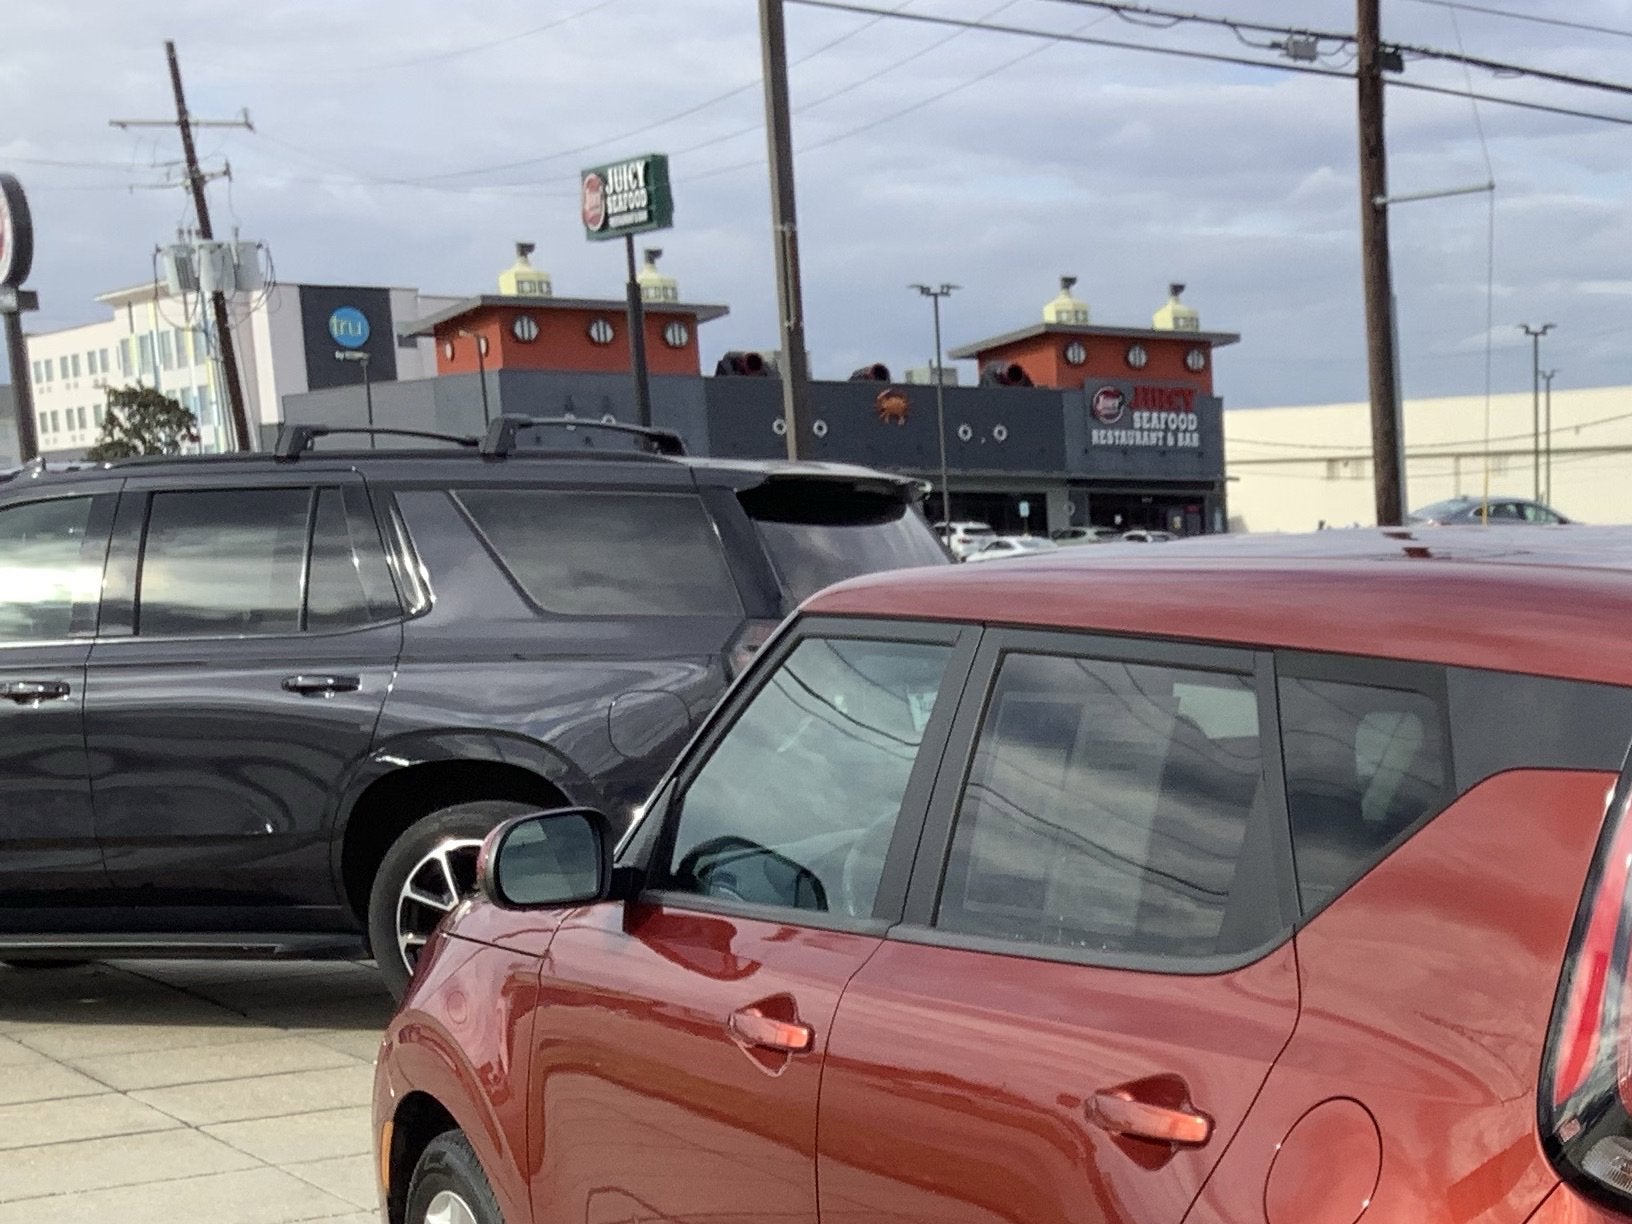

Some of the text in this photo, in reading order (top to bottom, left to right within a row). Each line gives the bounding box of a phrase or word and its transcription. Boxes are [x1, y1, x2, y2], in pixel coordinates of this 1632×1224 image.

[605, 160, 646, 194] JUICY
[606, 188, 648, 214] SEAFOOD
[331, 314, 362, 337] tru
[1132, 411, 1198, 431] SEAFOOD
[1091, 429, 1200, 447] RESTAURANT & BAR
